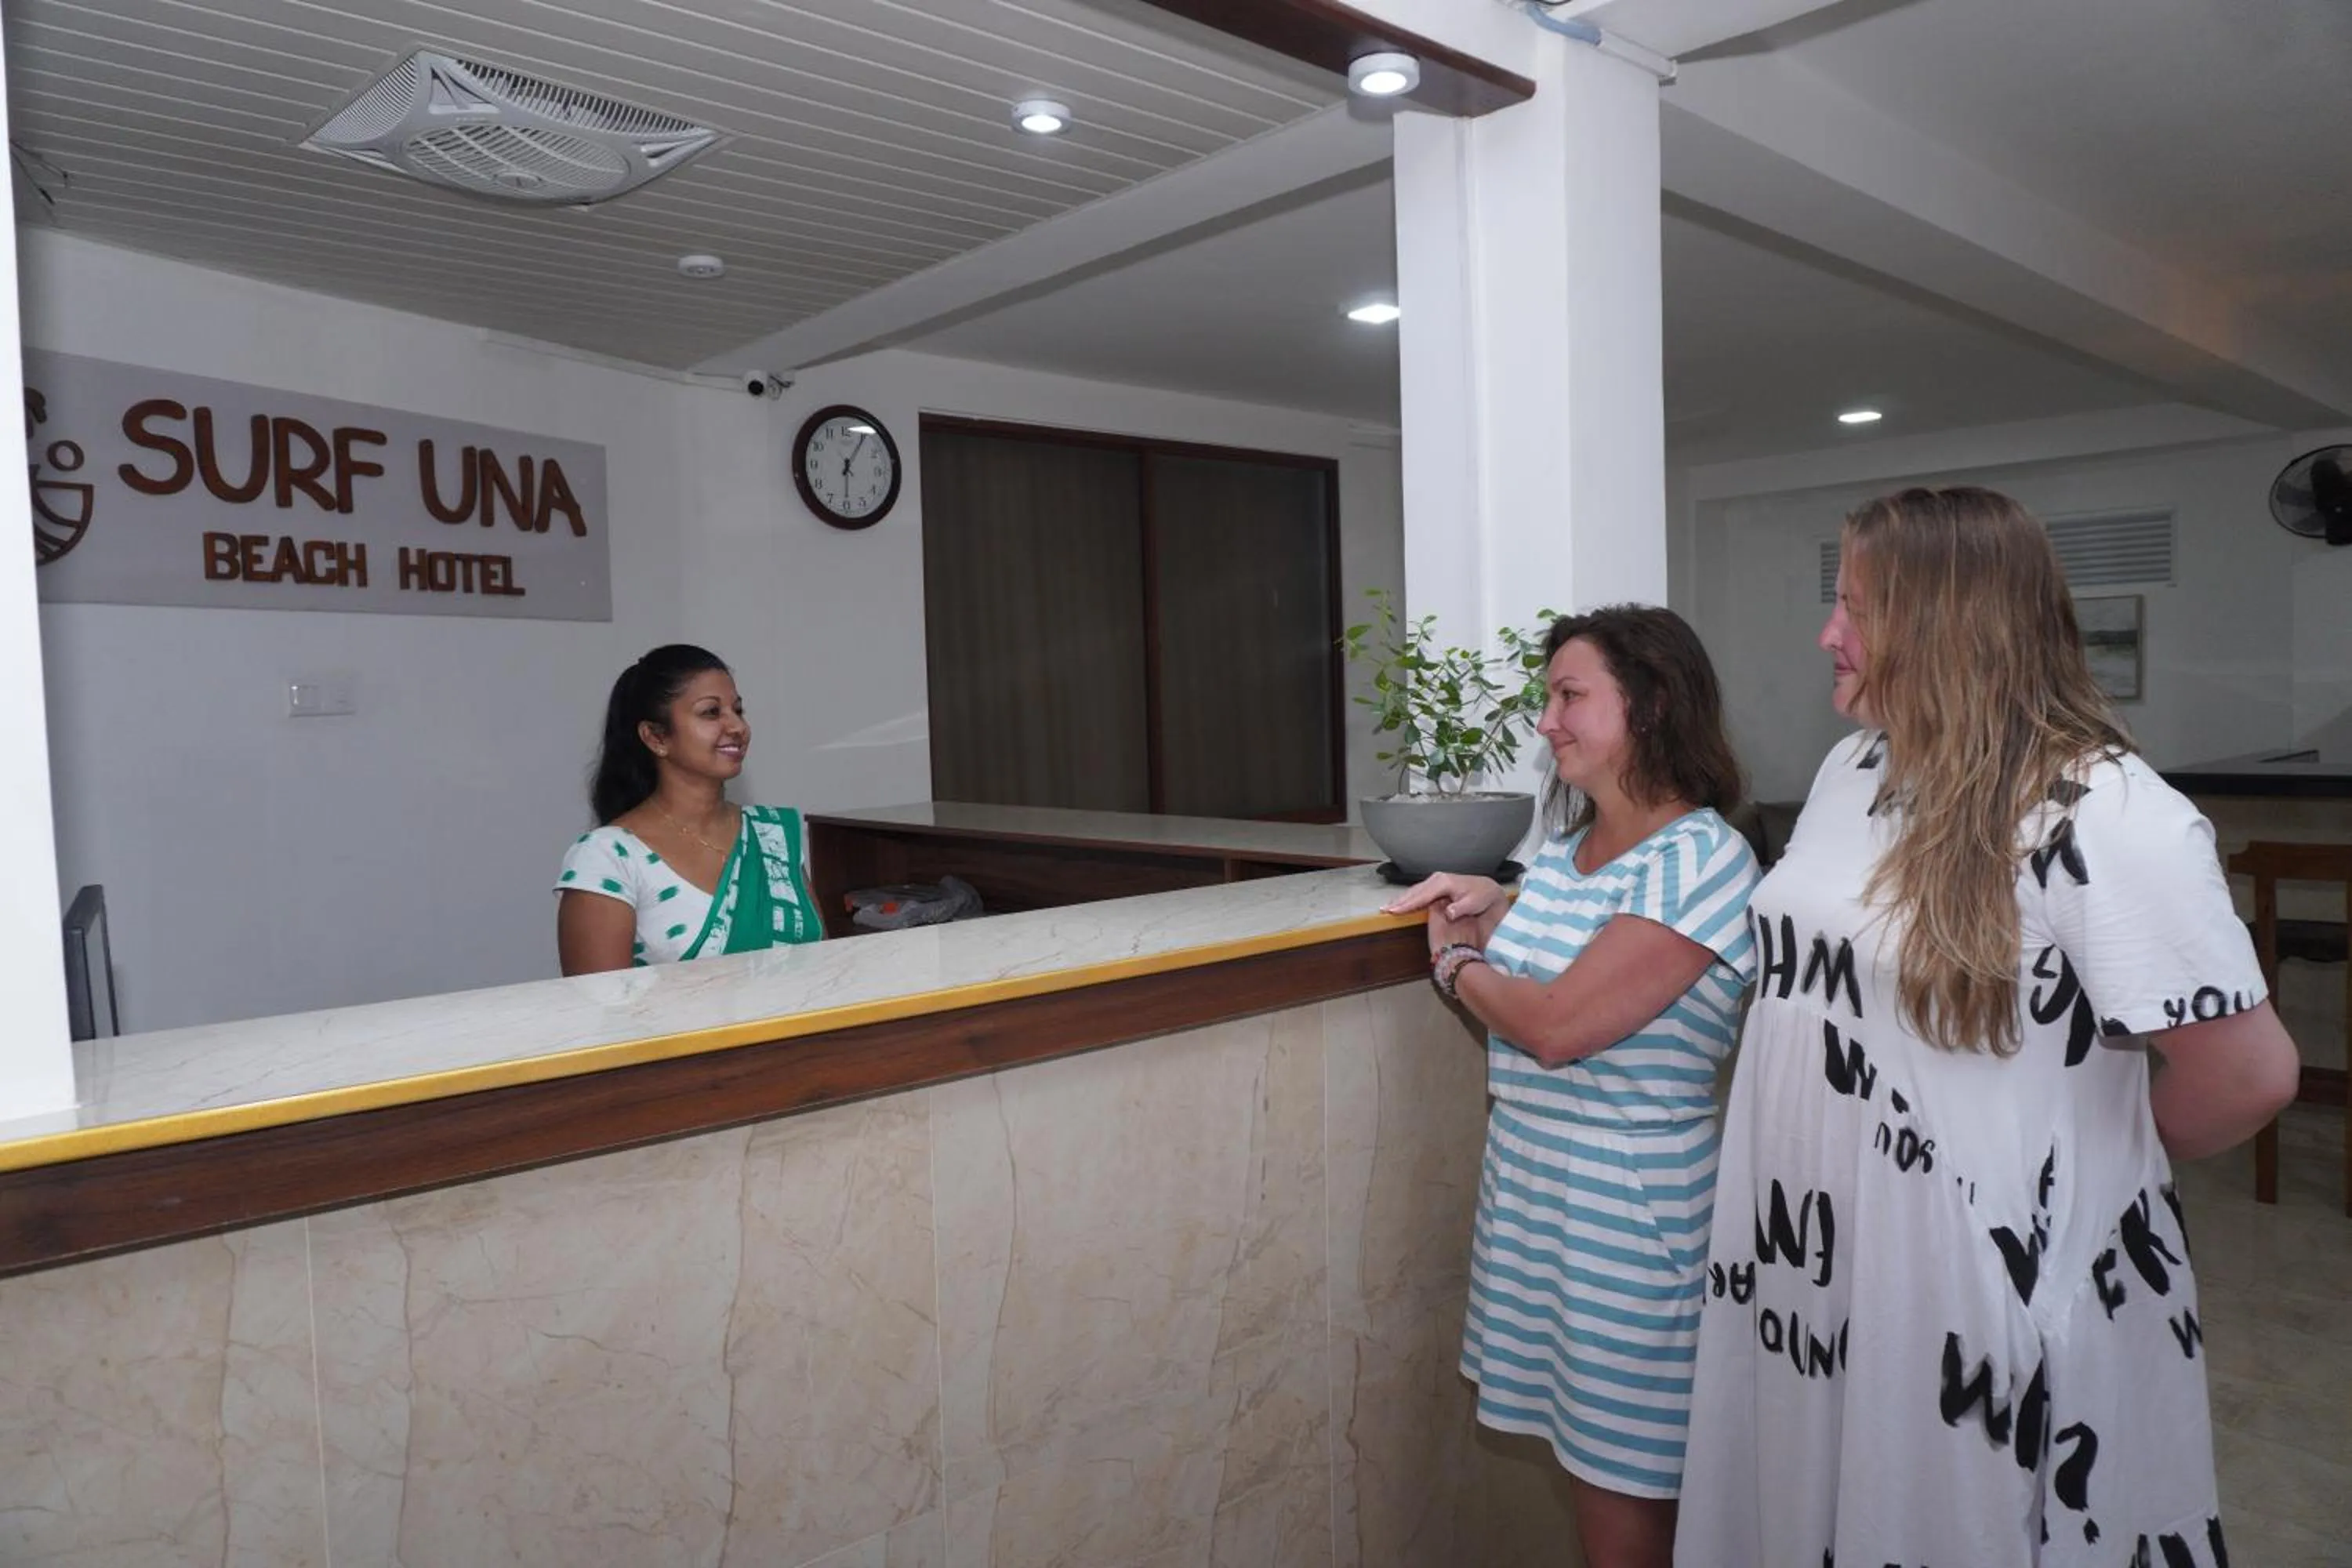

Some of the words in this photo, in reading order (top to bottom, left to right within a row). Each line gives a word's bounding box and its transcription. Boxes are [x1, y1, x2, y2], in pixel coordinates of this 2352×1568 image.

[118, 398, 387, 514] SURF
[419, 439, 586, 537] UNA
[203, 530, 368, 587] BEACH
[398, 546, 525, 596] HOTEL
